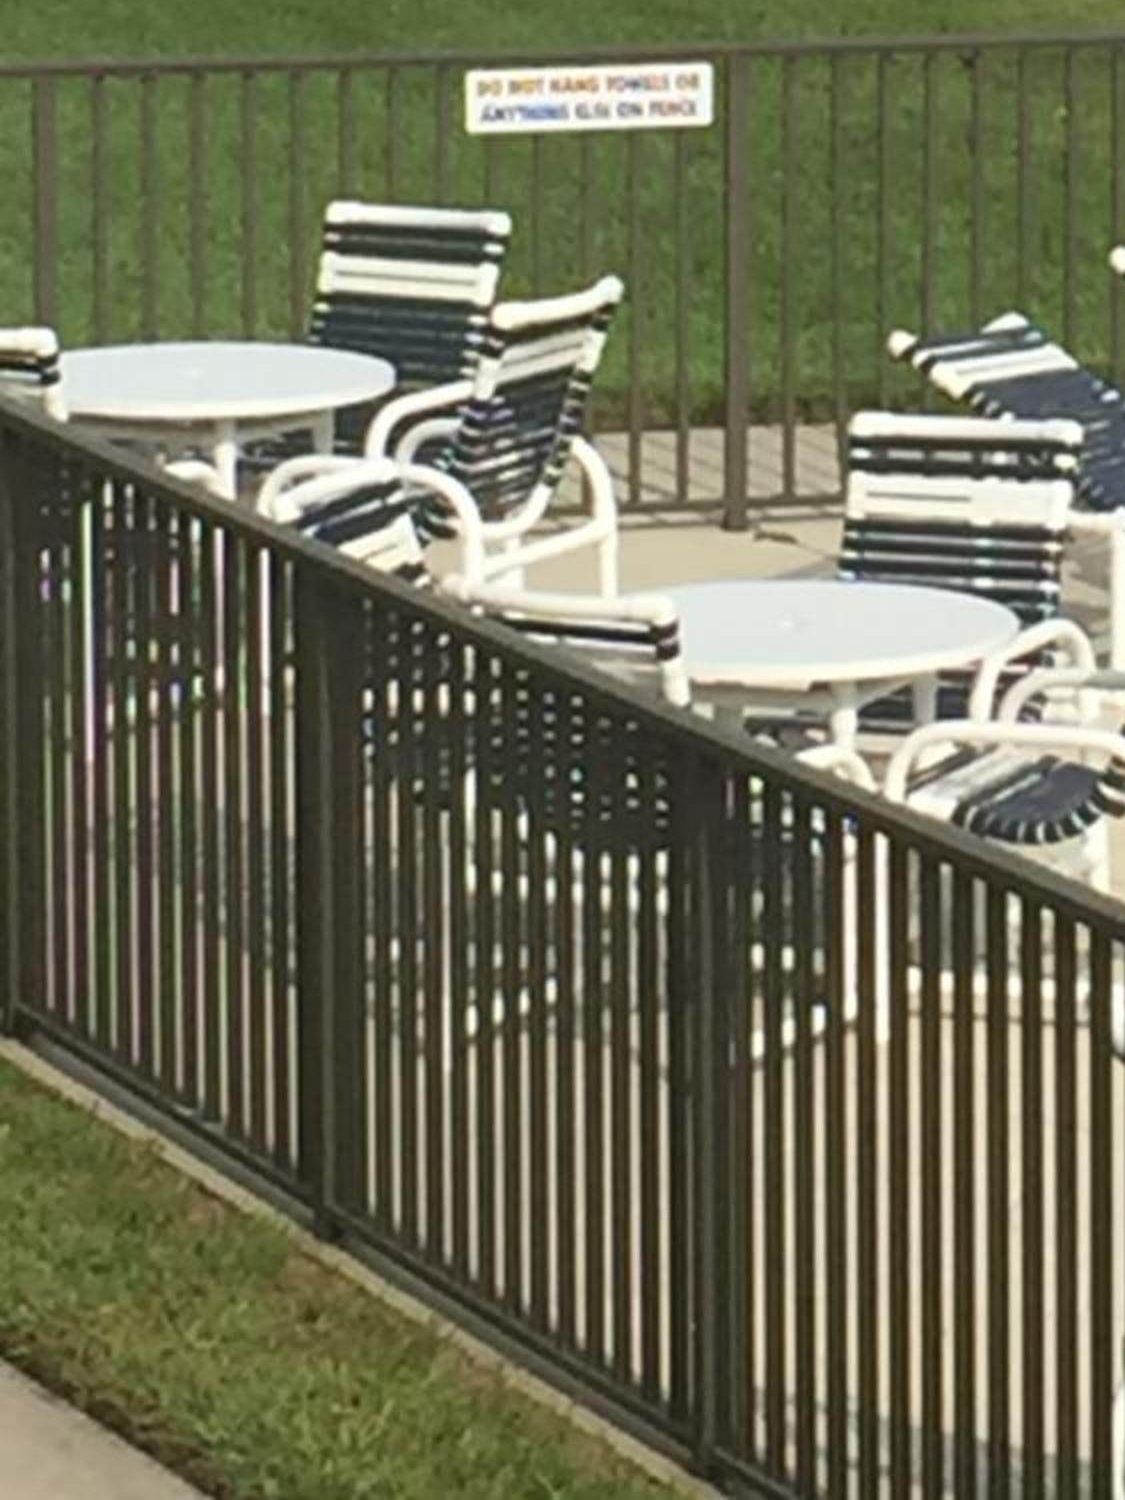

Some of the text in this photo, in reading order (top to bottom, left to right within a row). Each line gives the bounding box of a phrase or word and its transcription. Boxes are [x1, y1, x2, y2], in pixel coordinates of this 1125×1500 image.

[478, 79, 502, 96] DO
[509, 78, 544, 94] NOT
[616, 101, 643, 117] ON
